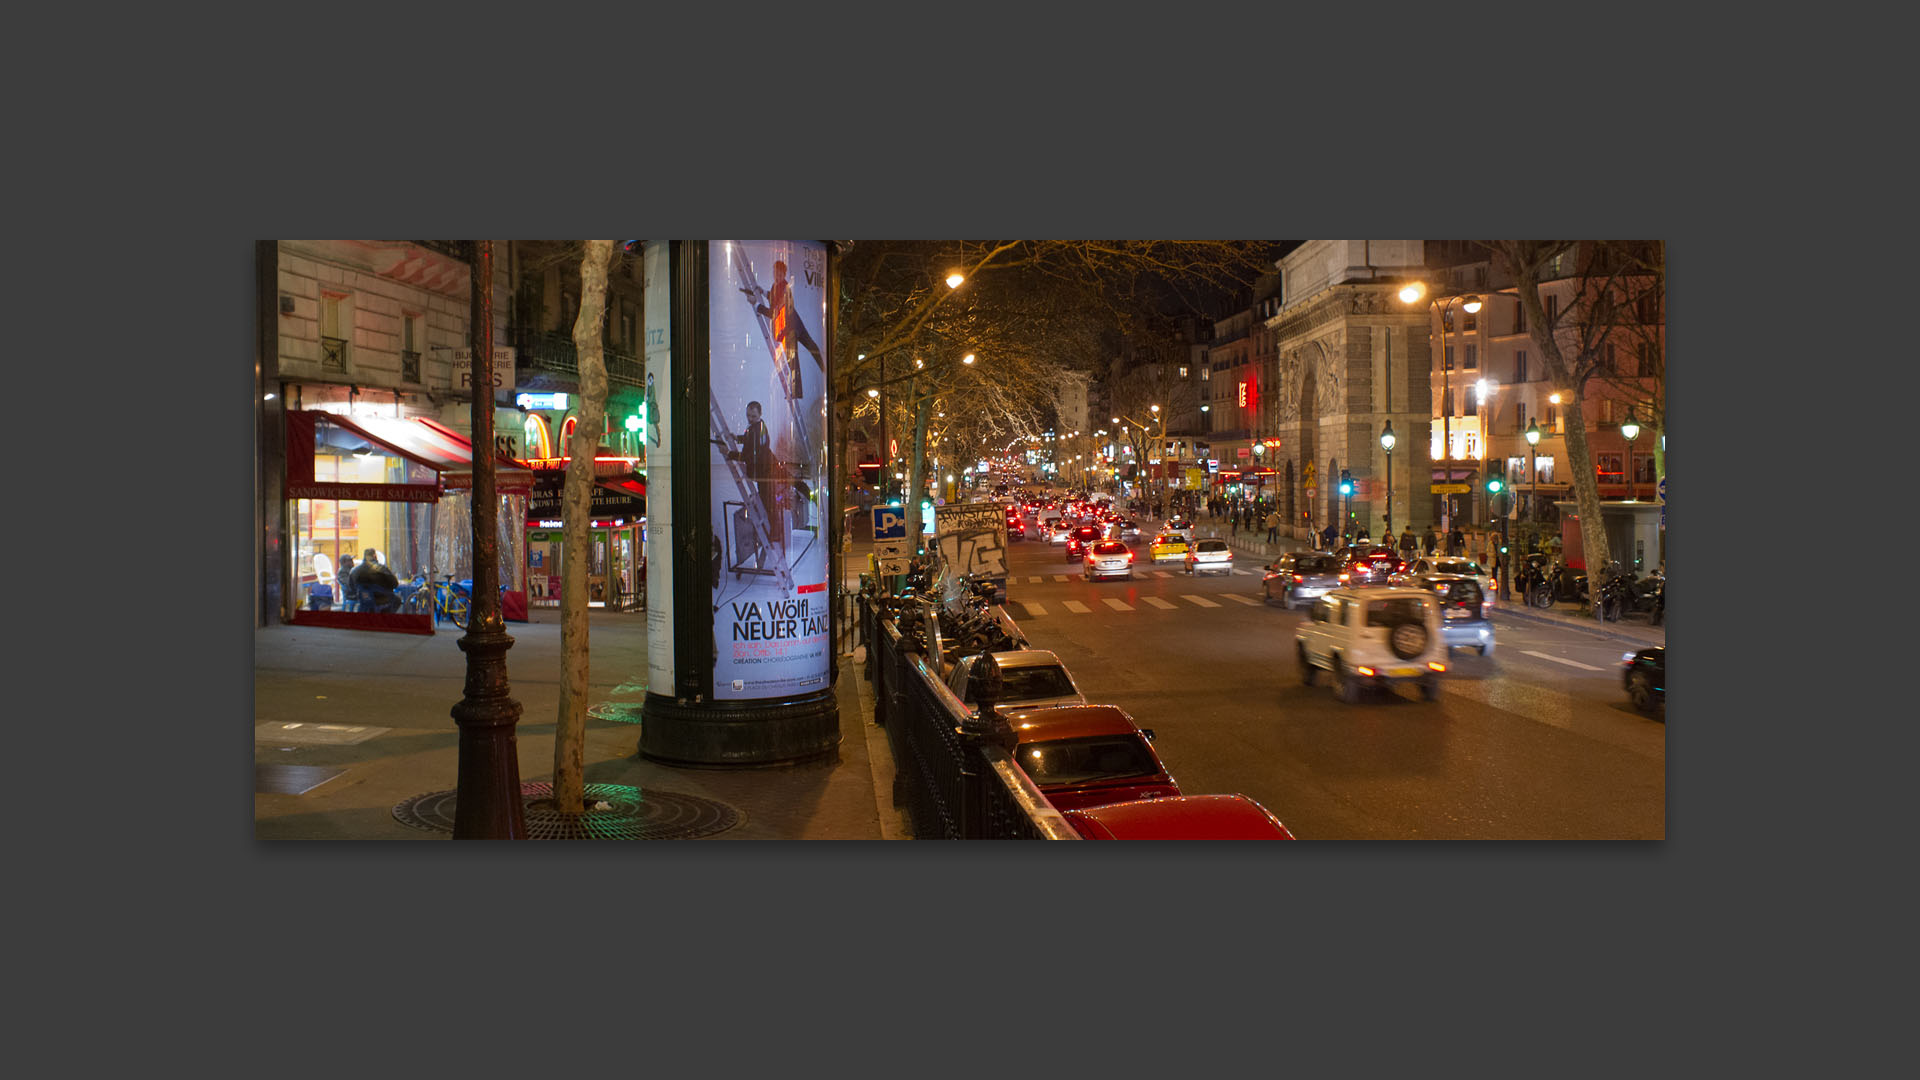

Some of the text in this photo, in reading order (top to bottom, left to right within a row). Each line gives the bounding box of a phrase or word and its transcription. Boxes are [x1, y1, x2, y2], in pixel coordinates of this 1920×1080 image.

[732, 602, 762, 622] VA
[767, 599, 808, 620] Wölfl
[733, 620, 796, 641] NEUER
